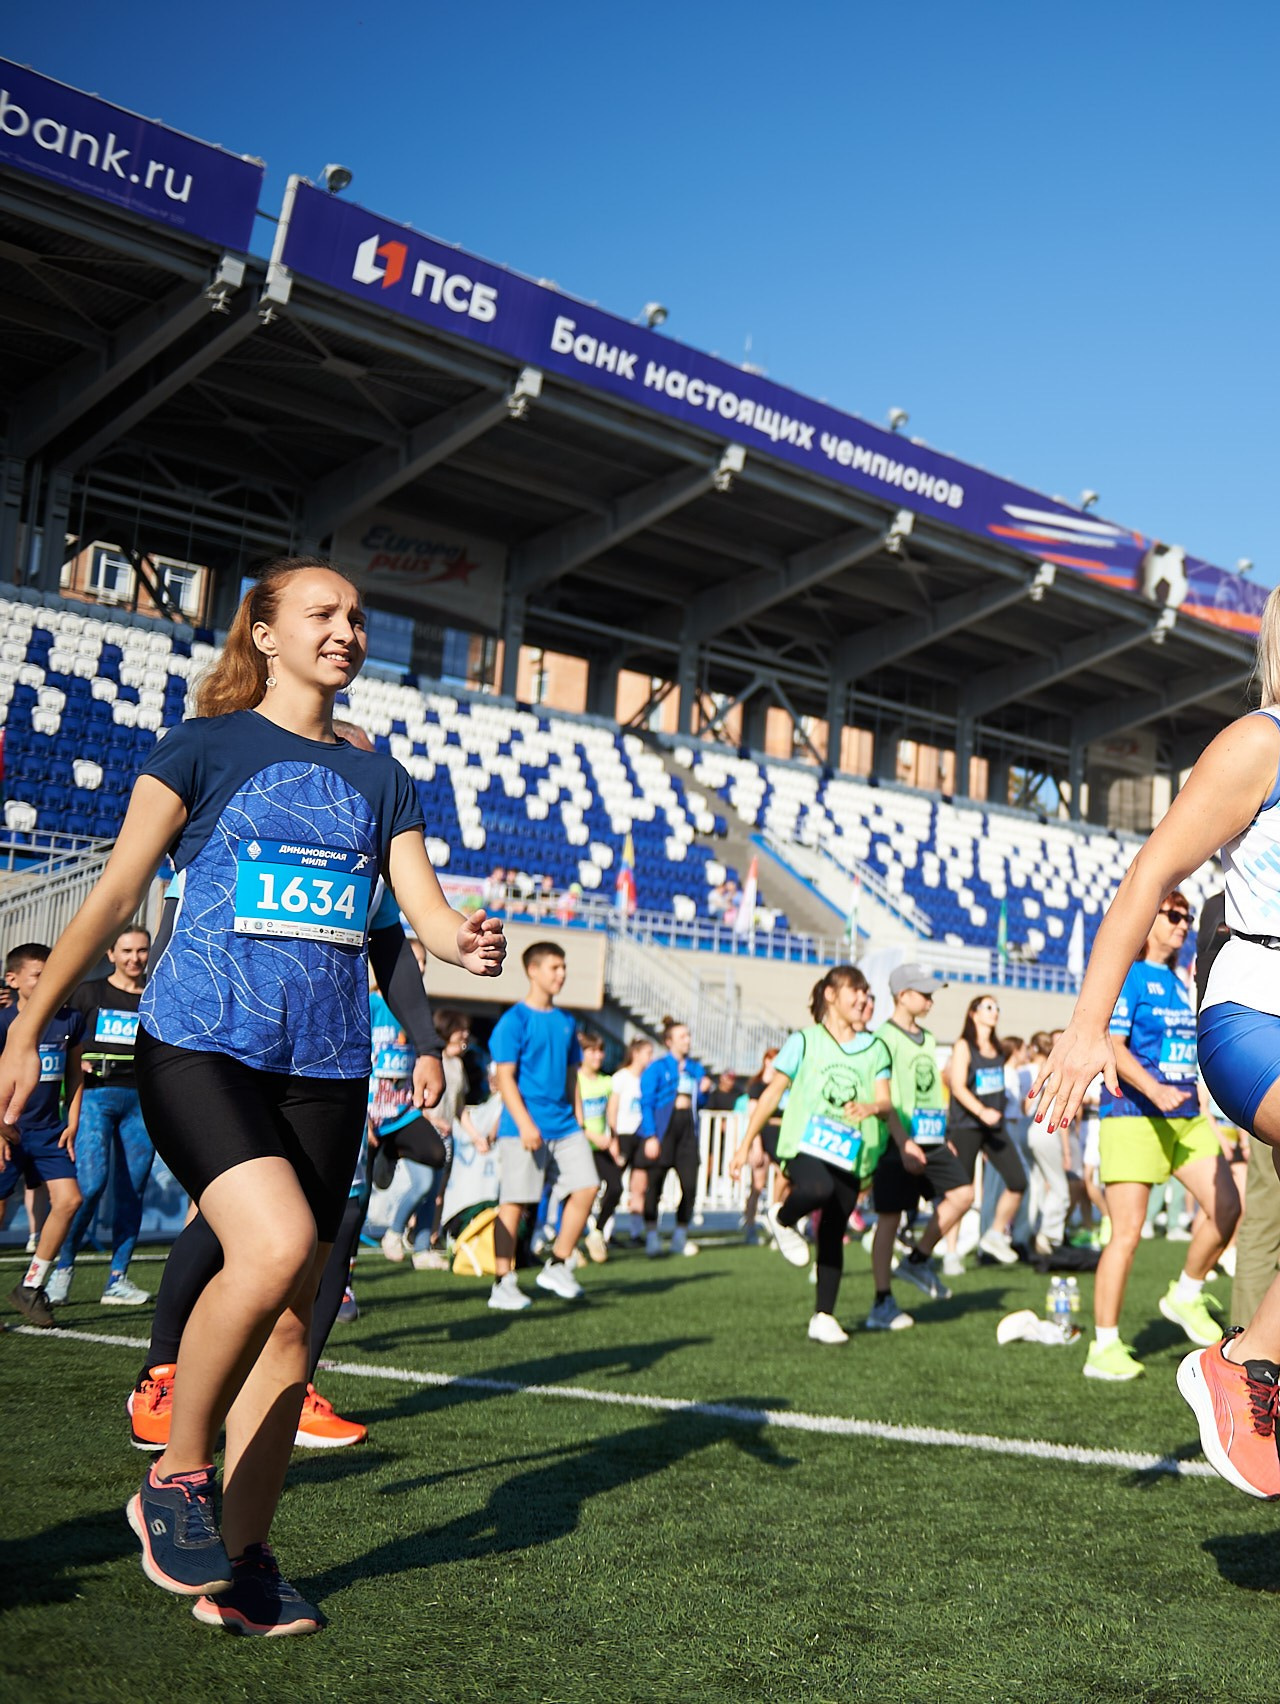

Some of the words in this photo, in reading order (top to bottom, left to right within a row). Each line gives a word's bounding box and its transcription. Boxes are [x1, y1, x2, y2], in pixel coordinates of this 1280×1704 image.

[411, 259, 498, 323] ПСБ
[551, 315, 639, 381] Банк
[643, 361, 816, 450] настоящих
[820, 432, 964, 509] чемпионов
[279, 845, 347, 860] ДИНАМОВСКАЯ
[301, 856, 328, 867] МИЛЯ
[257, 873, 356, 920] 1634
[809, 1127, 853, 1158] 1724
